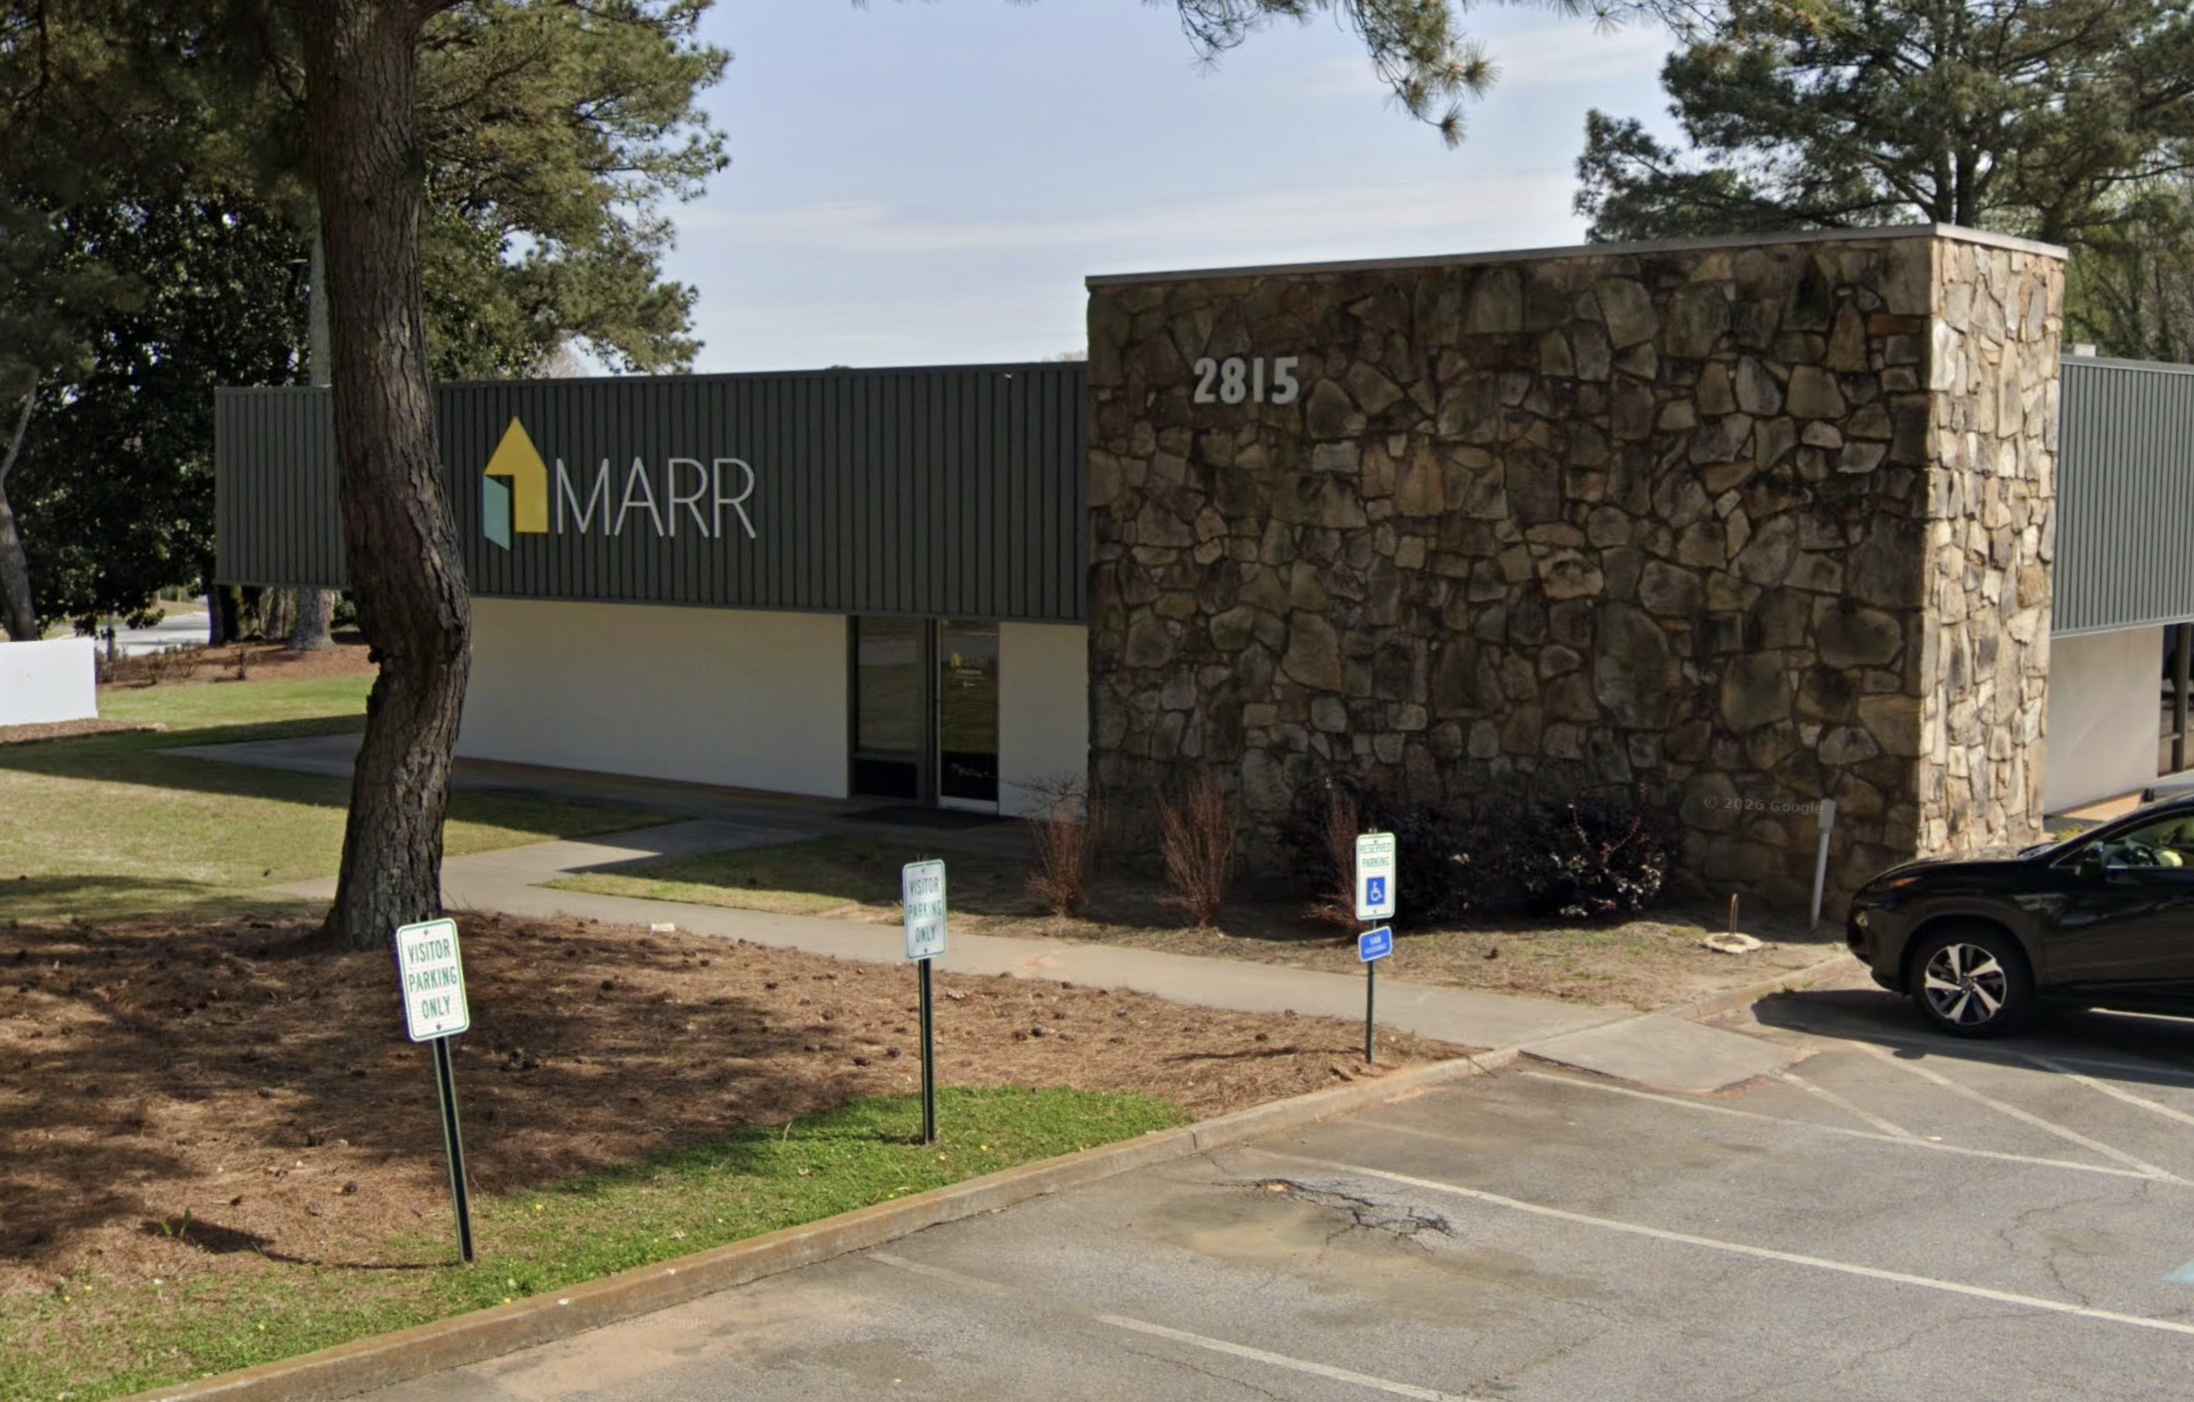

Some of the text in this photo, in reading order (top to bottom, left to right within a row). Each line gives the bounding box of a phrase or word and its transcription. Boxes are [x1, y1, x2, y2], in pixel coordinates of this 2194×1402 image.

[1194, 356, 1300, 404] 2815
[556, 456, 757, 539] MARR
[1362, 857, 1390, 868] PARKING
[909, 876, 940, 896] VISITOR
[907, 899, 942, 921] PARKING
[915, 924, 938, 943] ONLY
[407, 939, 452, 963] VISITOR
[408, 966, 458, 993] PARKING
[421, 995, 451, 1019] ONLY
